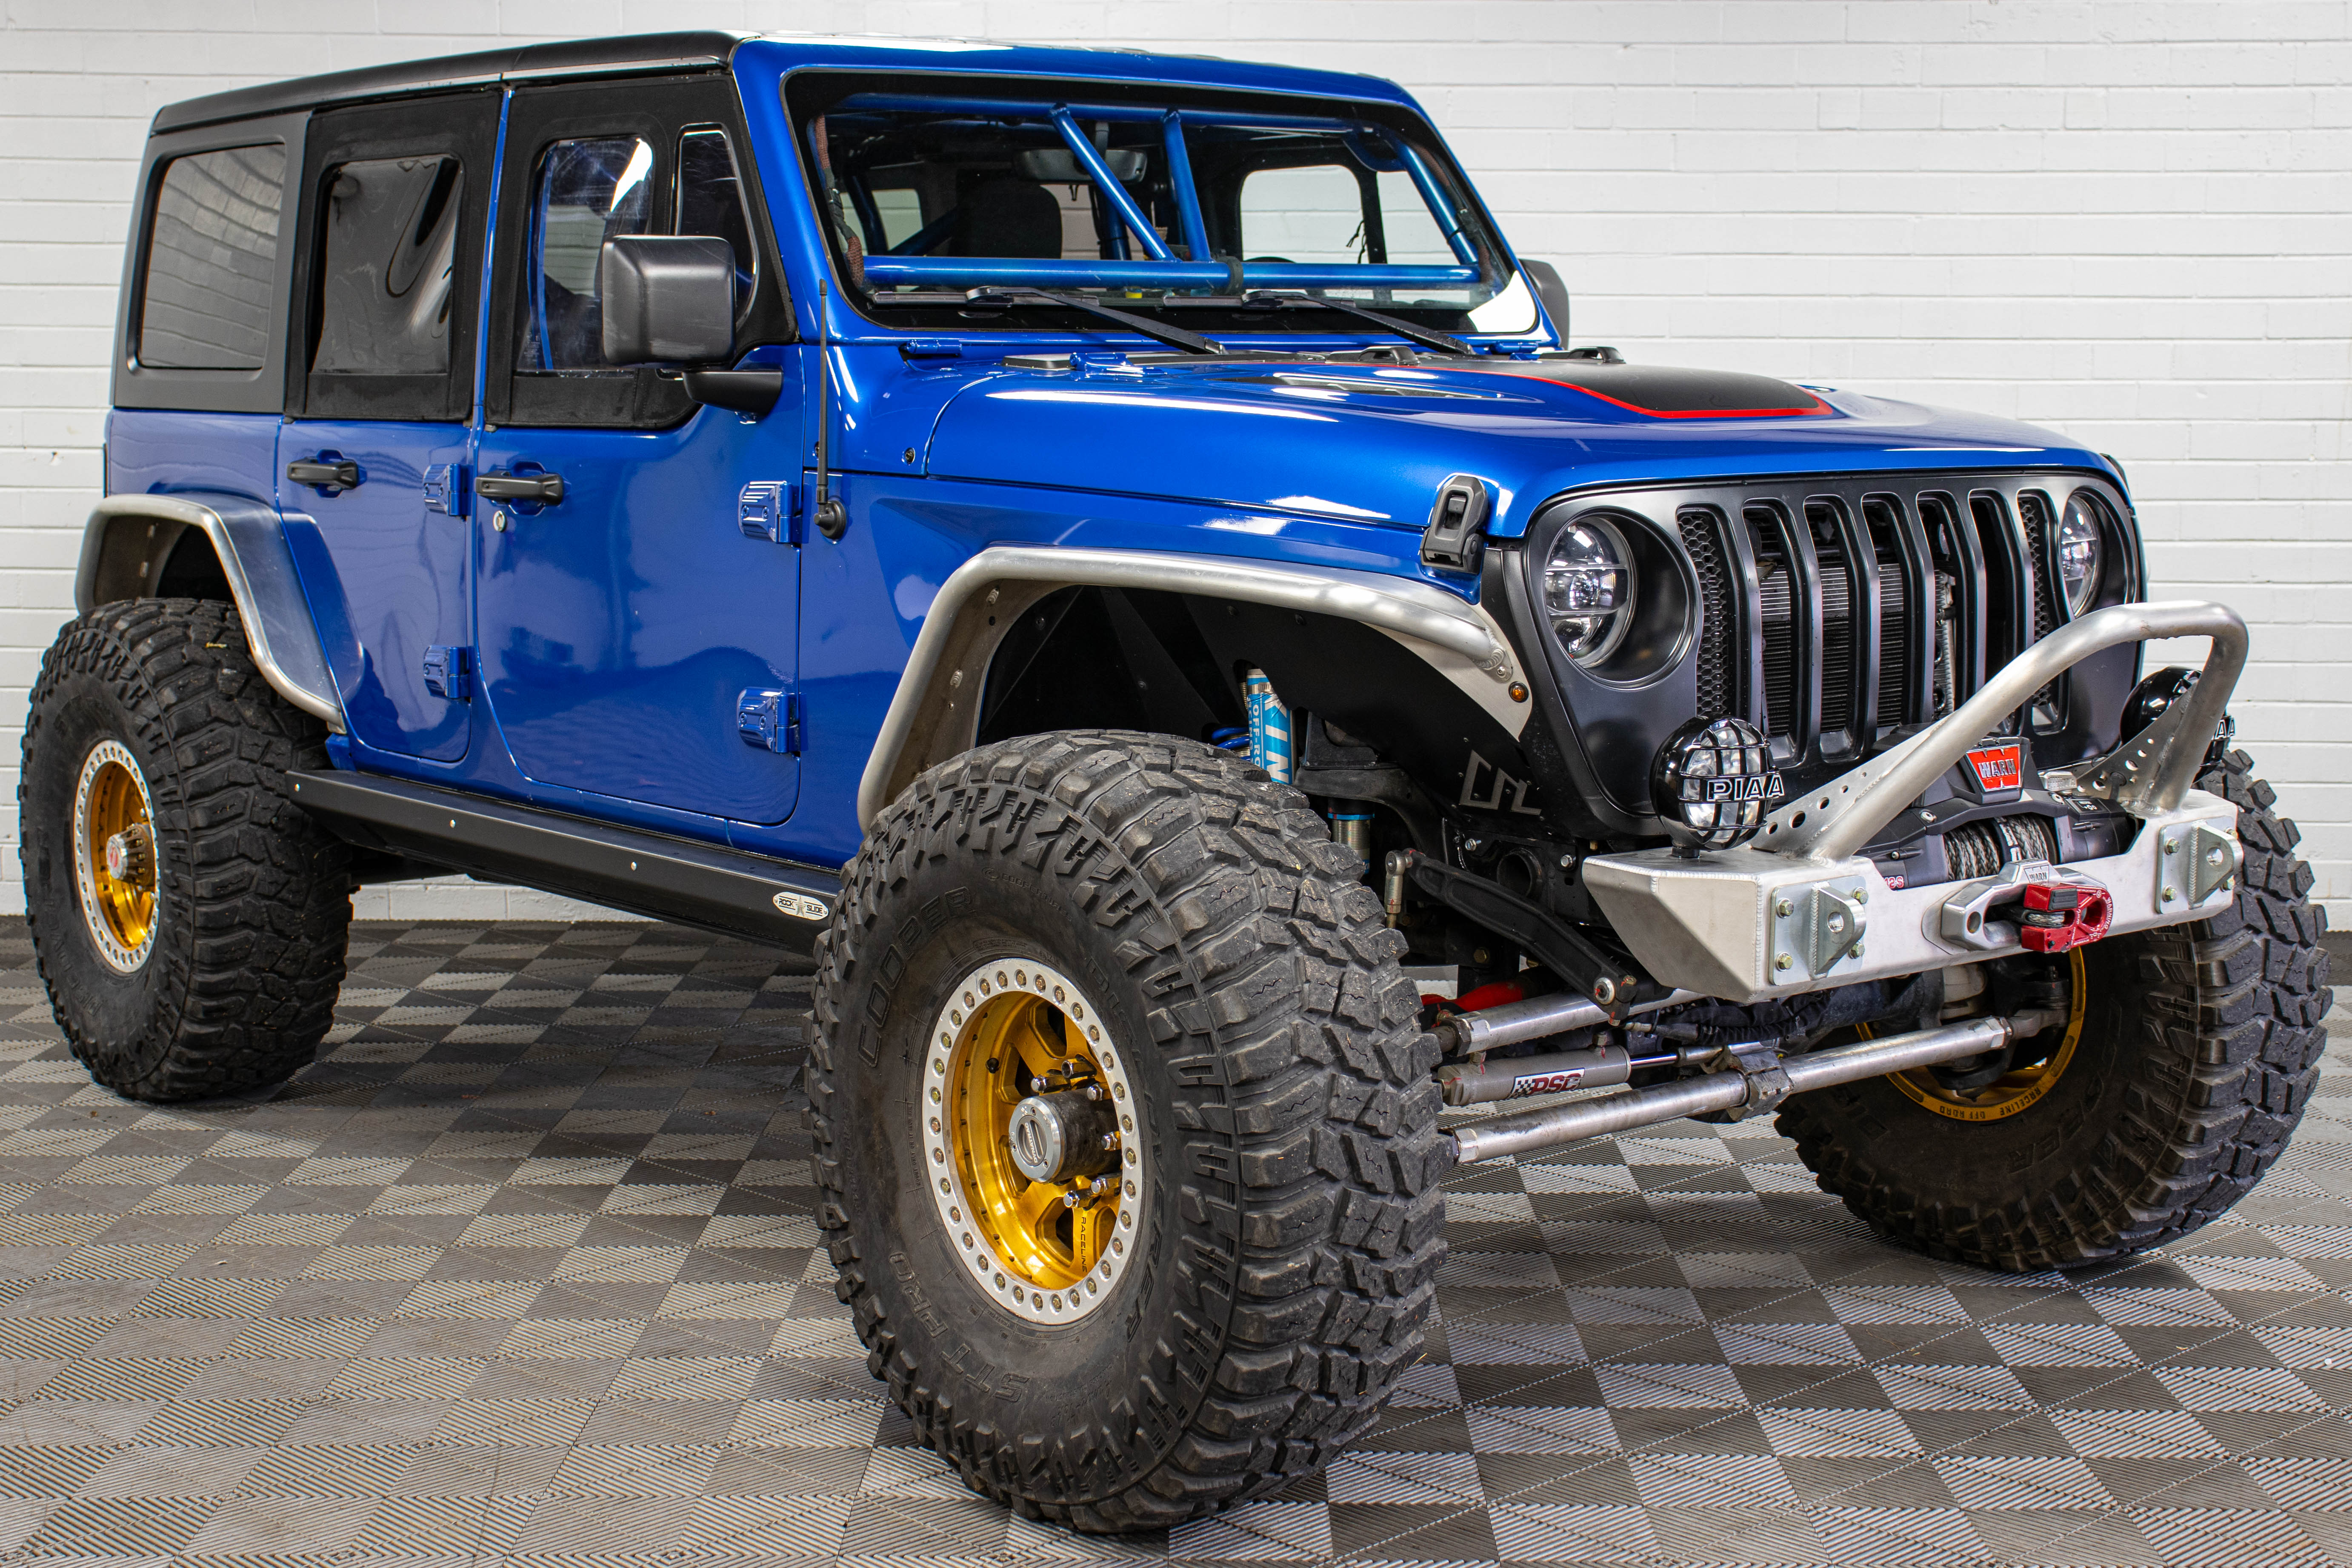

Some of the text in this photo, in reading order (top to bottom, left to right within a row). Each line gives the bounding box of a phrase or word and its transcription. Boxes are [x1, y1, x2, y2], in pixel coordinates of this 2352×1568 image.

[1265, 694, 1289, 784] KIN
[2214, 717, 2235, 740] AA
[1977, 758, 2016, 778] WARN
[1706, 774, 1784, 802] PIAA
[2029, 872, 2047, 882] WARN
[779, 898, 823, 914] ROCK SLIDE
[858, 886, 976, 1068] COOPER
[1939, 1087, 2042, 1119] RACELINE OFF ROAD
[1024, 1122, 1037, 1163] DYNATRAC
[889, 1251, 949, 1338] PRO
[941, 1343, 1030, 1403] STT
